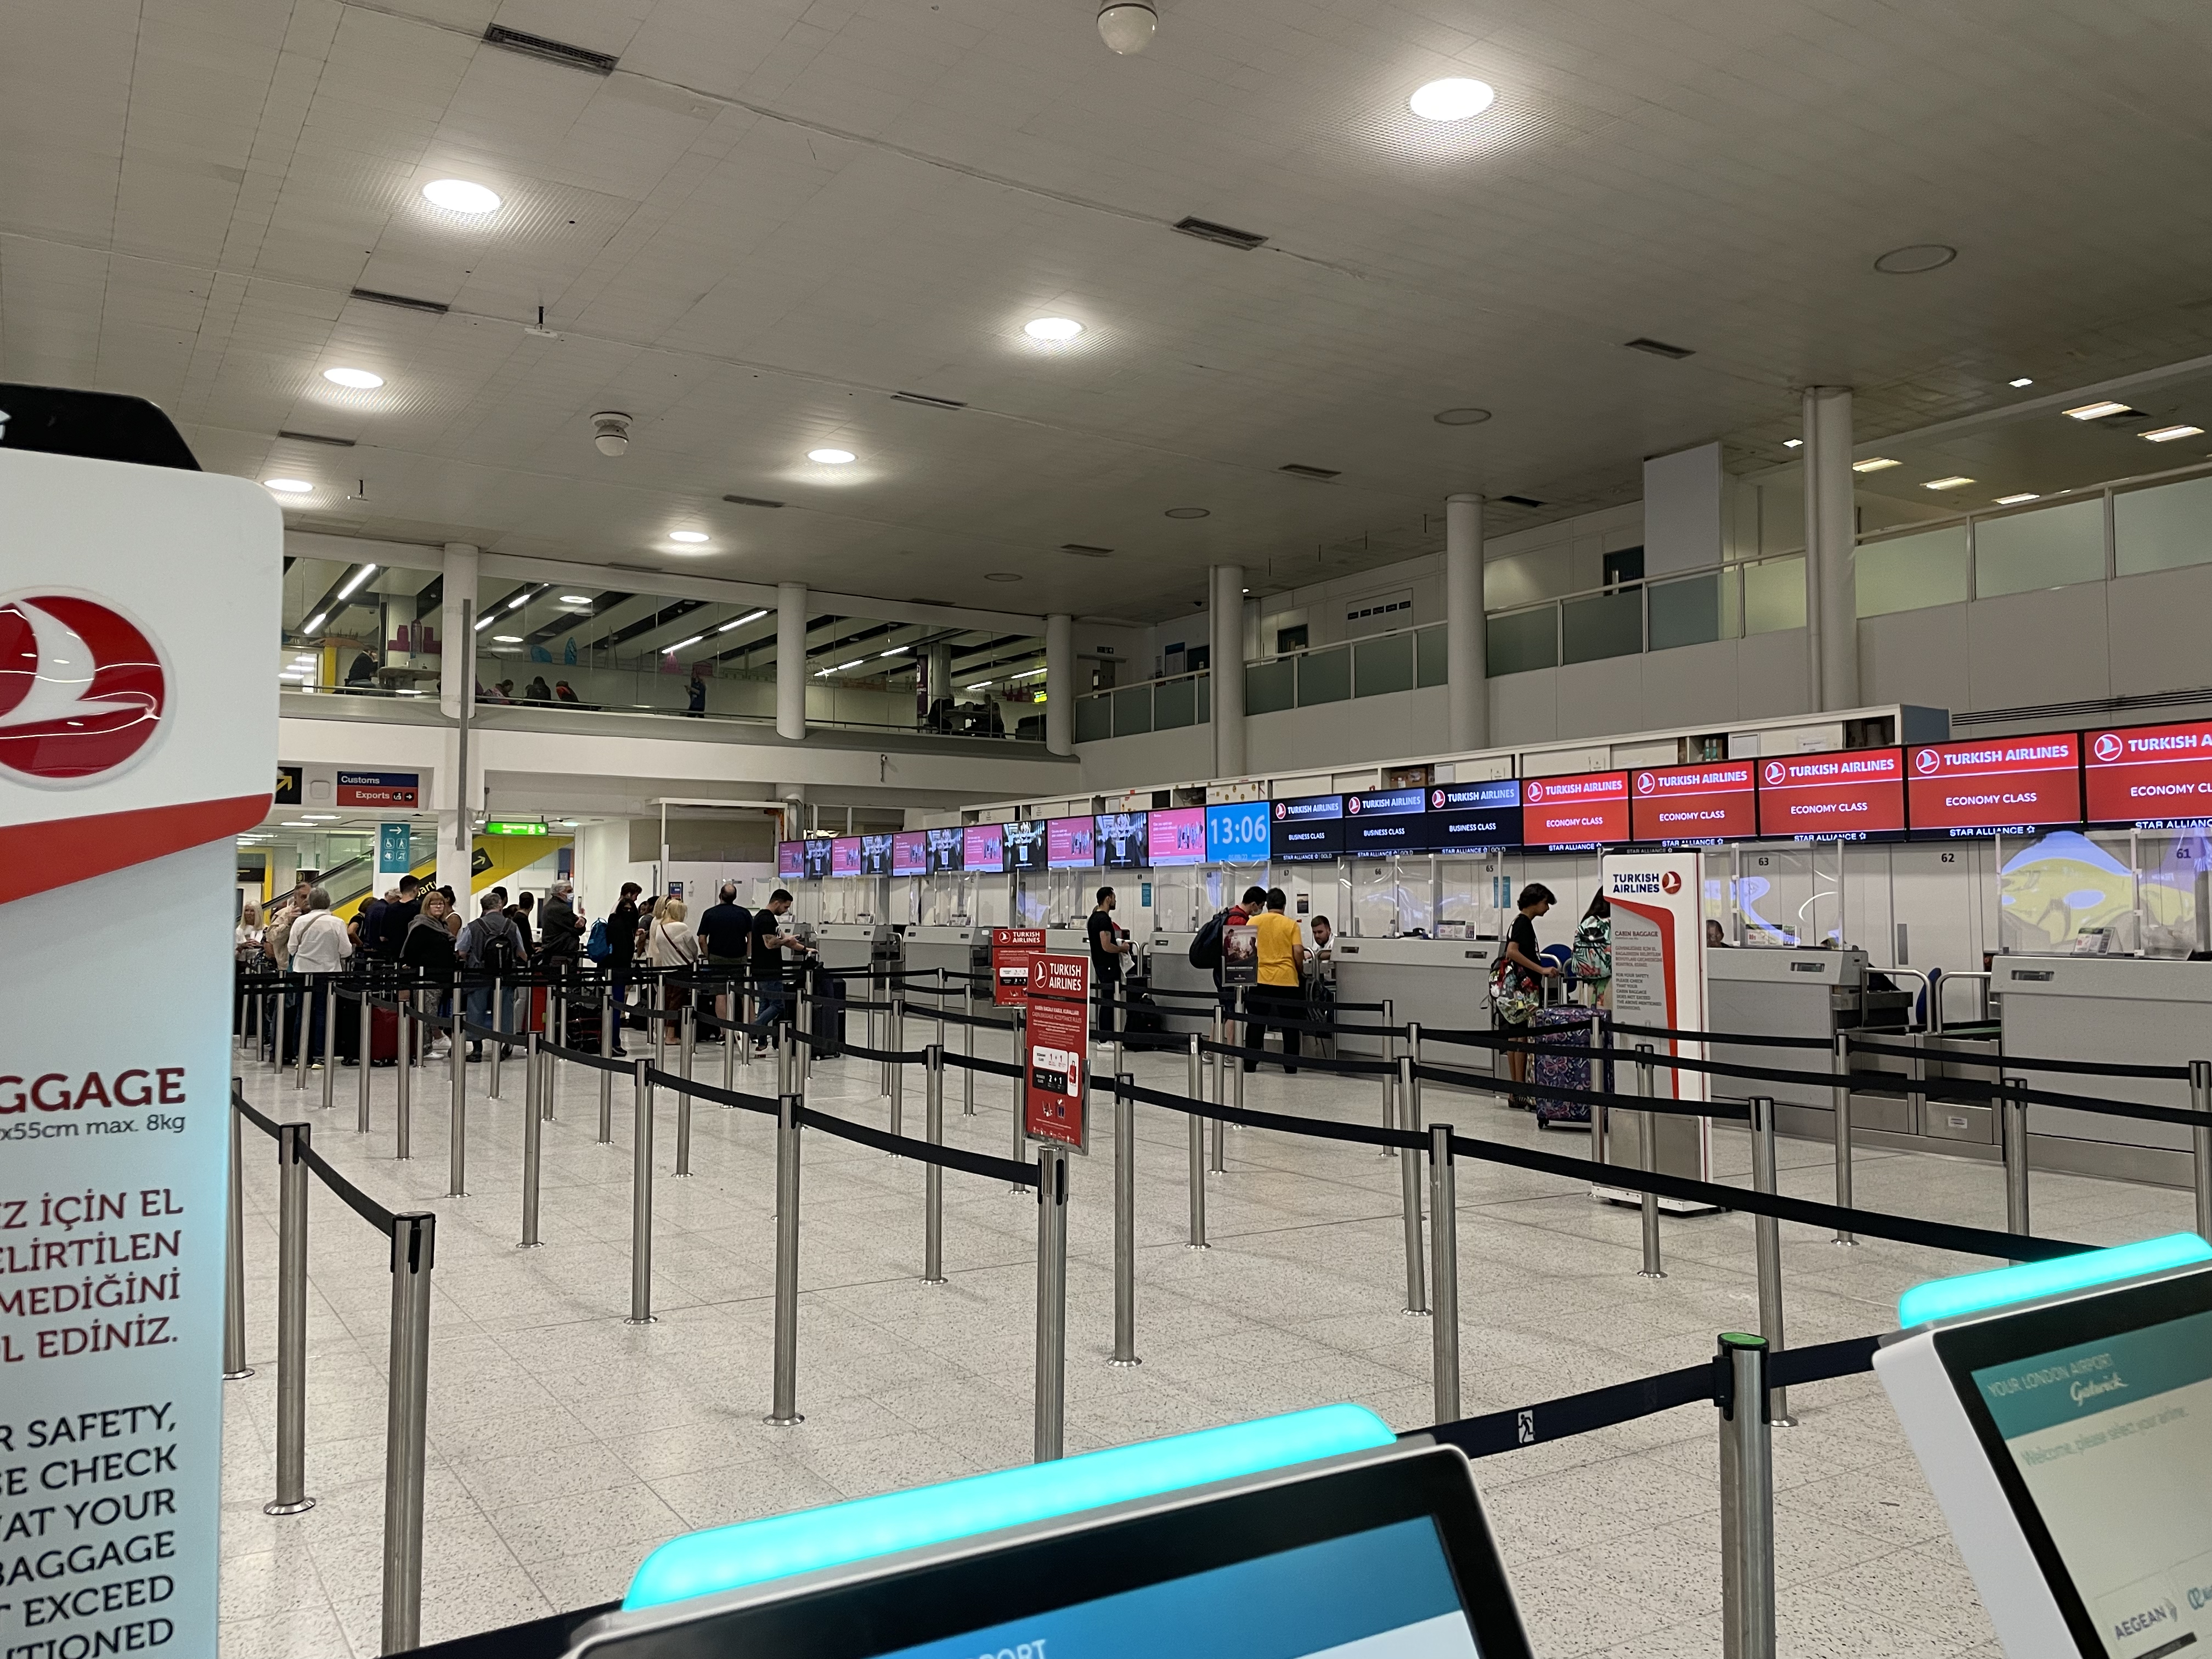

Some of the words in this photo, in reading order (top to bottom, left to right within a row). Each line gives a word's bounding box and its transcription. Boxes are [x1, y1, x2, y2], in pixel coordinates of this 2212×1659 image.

[2128, 735, 2197, 752] TURKISH
[1944, 751, 2002, 765] TURKISH
[2006, 746, 2068, 760] AIRLINES
[1790, 763, 1838, 777] TURKISH
[1841, 759, 1894, 773] AIRLINES
[341, 776, 380, 784] Customs
[1658, 774, 1700, 787] TURKISH
[1702, 770, 1747, 783] AIRLINES
[1545, 783, 1582, 795] TURKISH
[1583, 780, 1622, 792] AIRLINES
[2130, 783, 2194, 797] ECONOMY
[356, 791, 390, 799] Exports
[1362, 799, 1390, 808] TURKISH
[1391, 796, 1421, 806] AIRLINES
[1447, 792, 1479, 802] TURKISH
[1481, 789, 1515, 799] AIRLINES
[1945, 795, 2000, 806] ECONOMY
[2002, 793, 2037, 803] CLASS
[1288, 804, 1312, 814] TURKISH
[1313, 803, 1339, 812] AIRLINES
[1791, 804, 1836, 814] ECONOMY
[1838, 803, 1867, 812] CLASS
[1546, 818, 1581, 827] ECONOMY
[1582, 817, 1603, 825] CLASS
[1659, 812, 1698, 822] ECONOMY
[1700, 810, 1725, 819] CLASS
[1211, 815, 1267, 844] 13:06
[1449, 824, 1476, 832] BUSINESS
[1976, 827, 2023, 835] ALLIANCE
[1941, 853, 1955, 863] 62
[2176, 849, 2191, 859] 61
[1759, 857, 1769, 866] 63
[1613, 873, 1659, 883] TURKISH
[1613, 884, 1660, 893] AIRLINES
[1050, 963, 1081, 977] TURKISH
[1049, 977, 1081, 991] AIRLINES
[0, 1068, 186, 1114] GGAGE
[0, 1121, 79, 1141] x55cm
[86, 1120, 139, 1135] max.
[146, 1114, 185, 1133] 8kg
[0, 1200, 27, 1229] Z
[40, 1188, 127, 1232] İÇİN
[139, 1188, 184, 1217] EL
[0, 1229, 182, 1274] LİRTİLEN
[0, 1267, 180, 1316] MEDİĞİNİ
[36, 1313, 178, 1358] EDİNİZ.
[2022, 1366, 2069, 1390] LONDON
[27, 1402, 176, 1448] SAFETY,
[0, 1467, 27, 1497] E
[40, 1444, 177, 1490] CHECK
[0, 1506, 56, 1543] AT
[64, 1488, 176, 1530] YOUR
[0, 1531, 175, 1587] AGGAGE
[23, 1575, 174, 1627] EXCEED
[2114, 1604, 2168, 1641] AEGEAN
